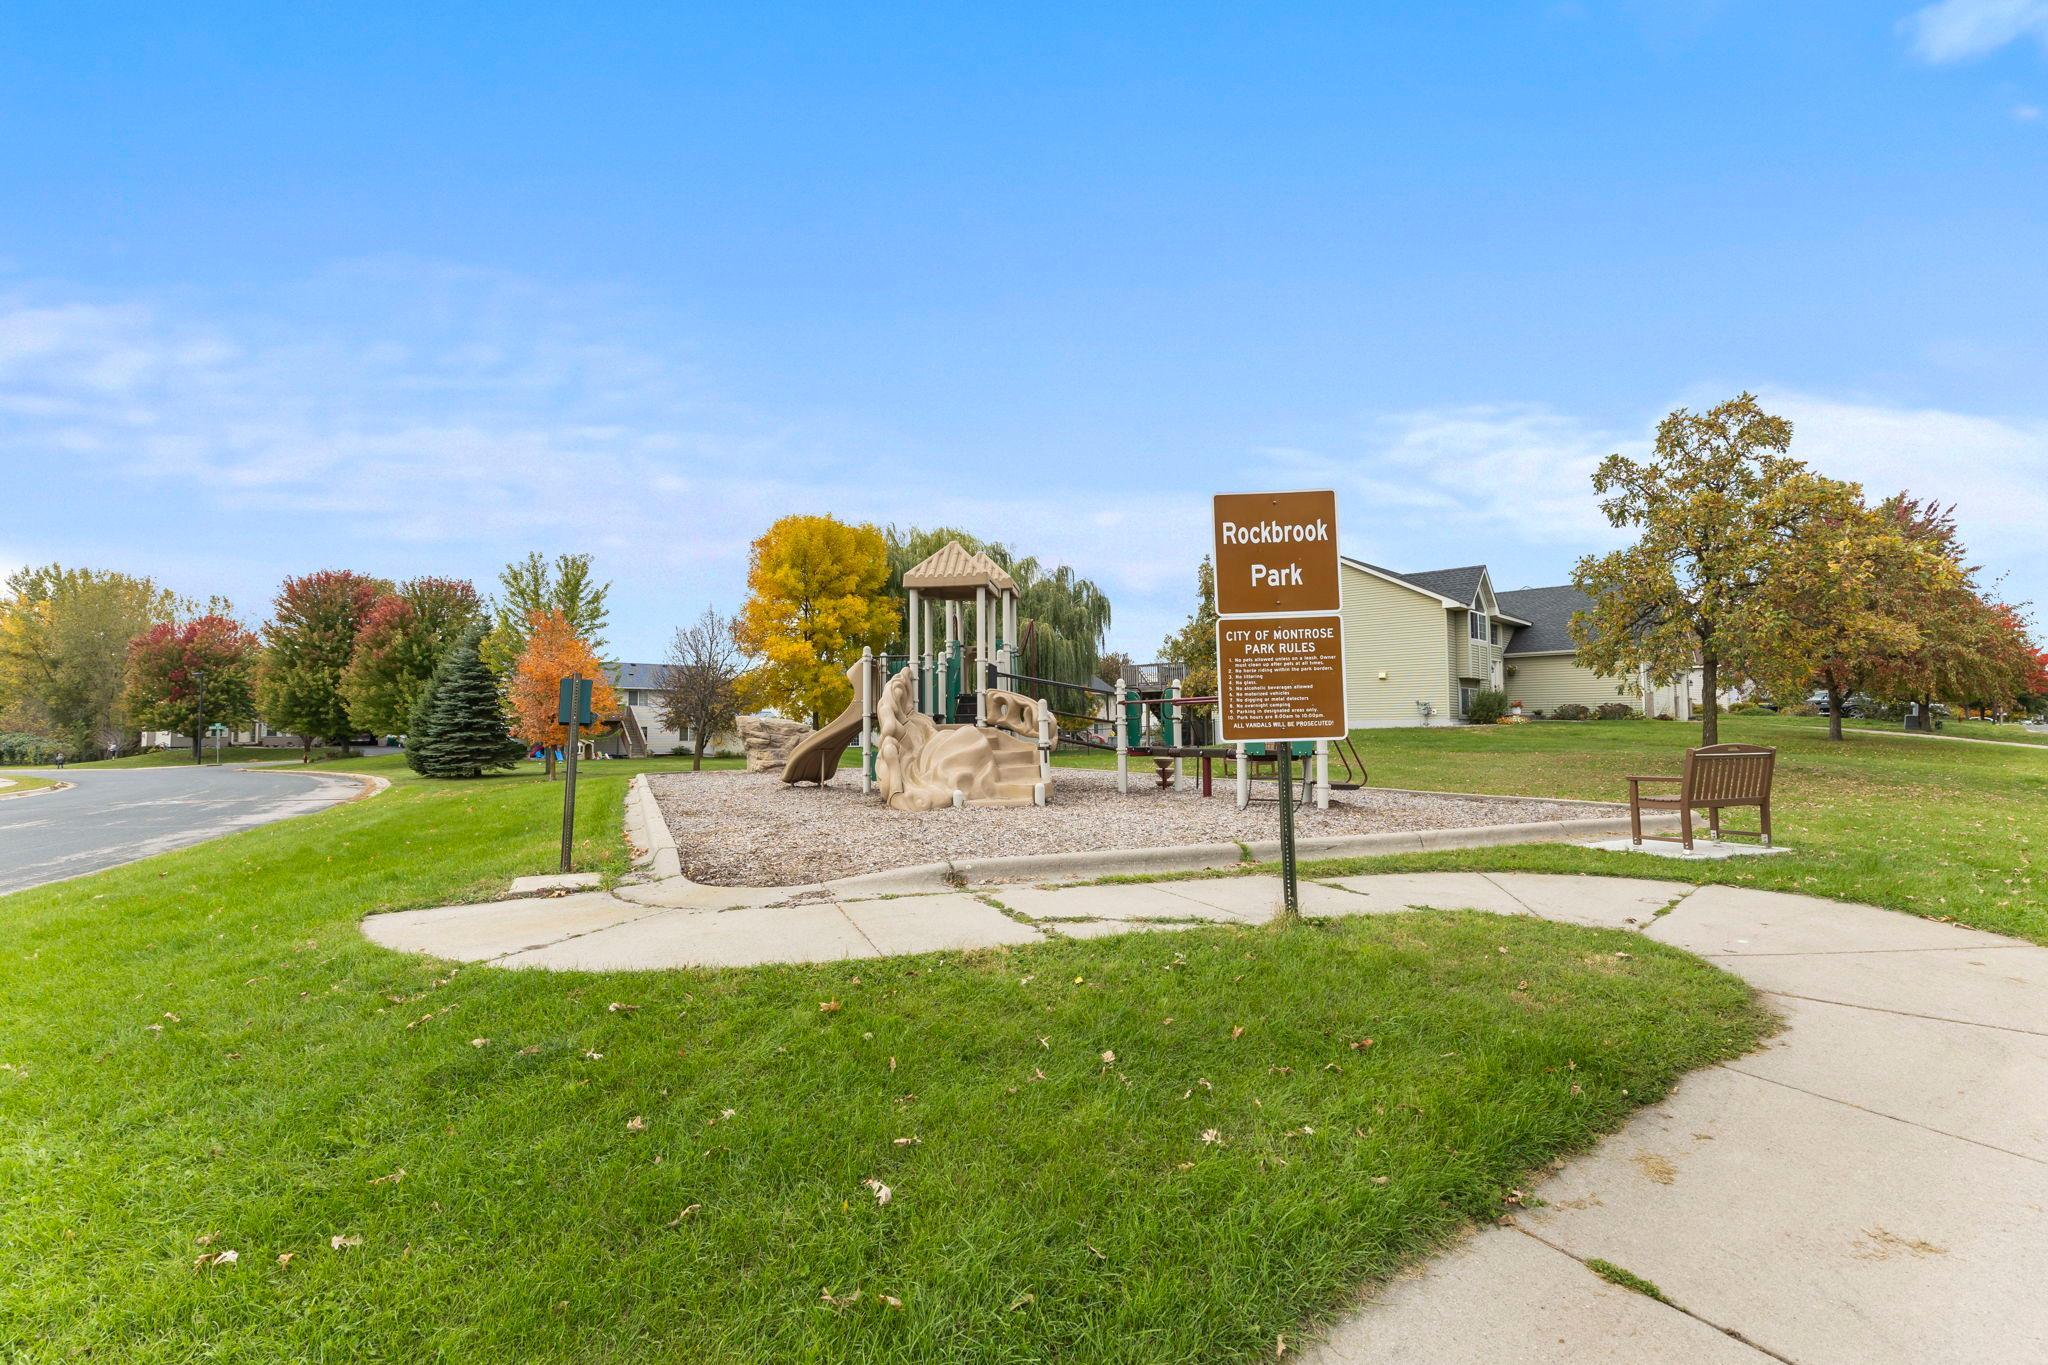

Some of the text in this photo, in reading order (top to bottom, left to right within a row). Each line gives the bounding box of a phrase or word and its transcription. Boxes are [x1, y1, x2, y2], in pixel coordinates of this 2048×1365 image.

[1223, 518, 1328, 545] Rockbrook
[1251, 563, 1303, 587] Park
[1226, 628, 1334, 641] CITY OF MONTROSE
[1245, 642, 1316, 654] PARK RULES
